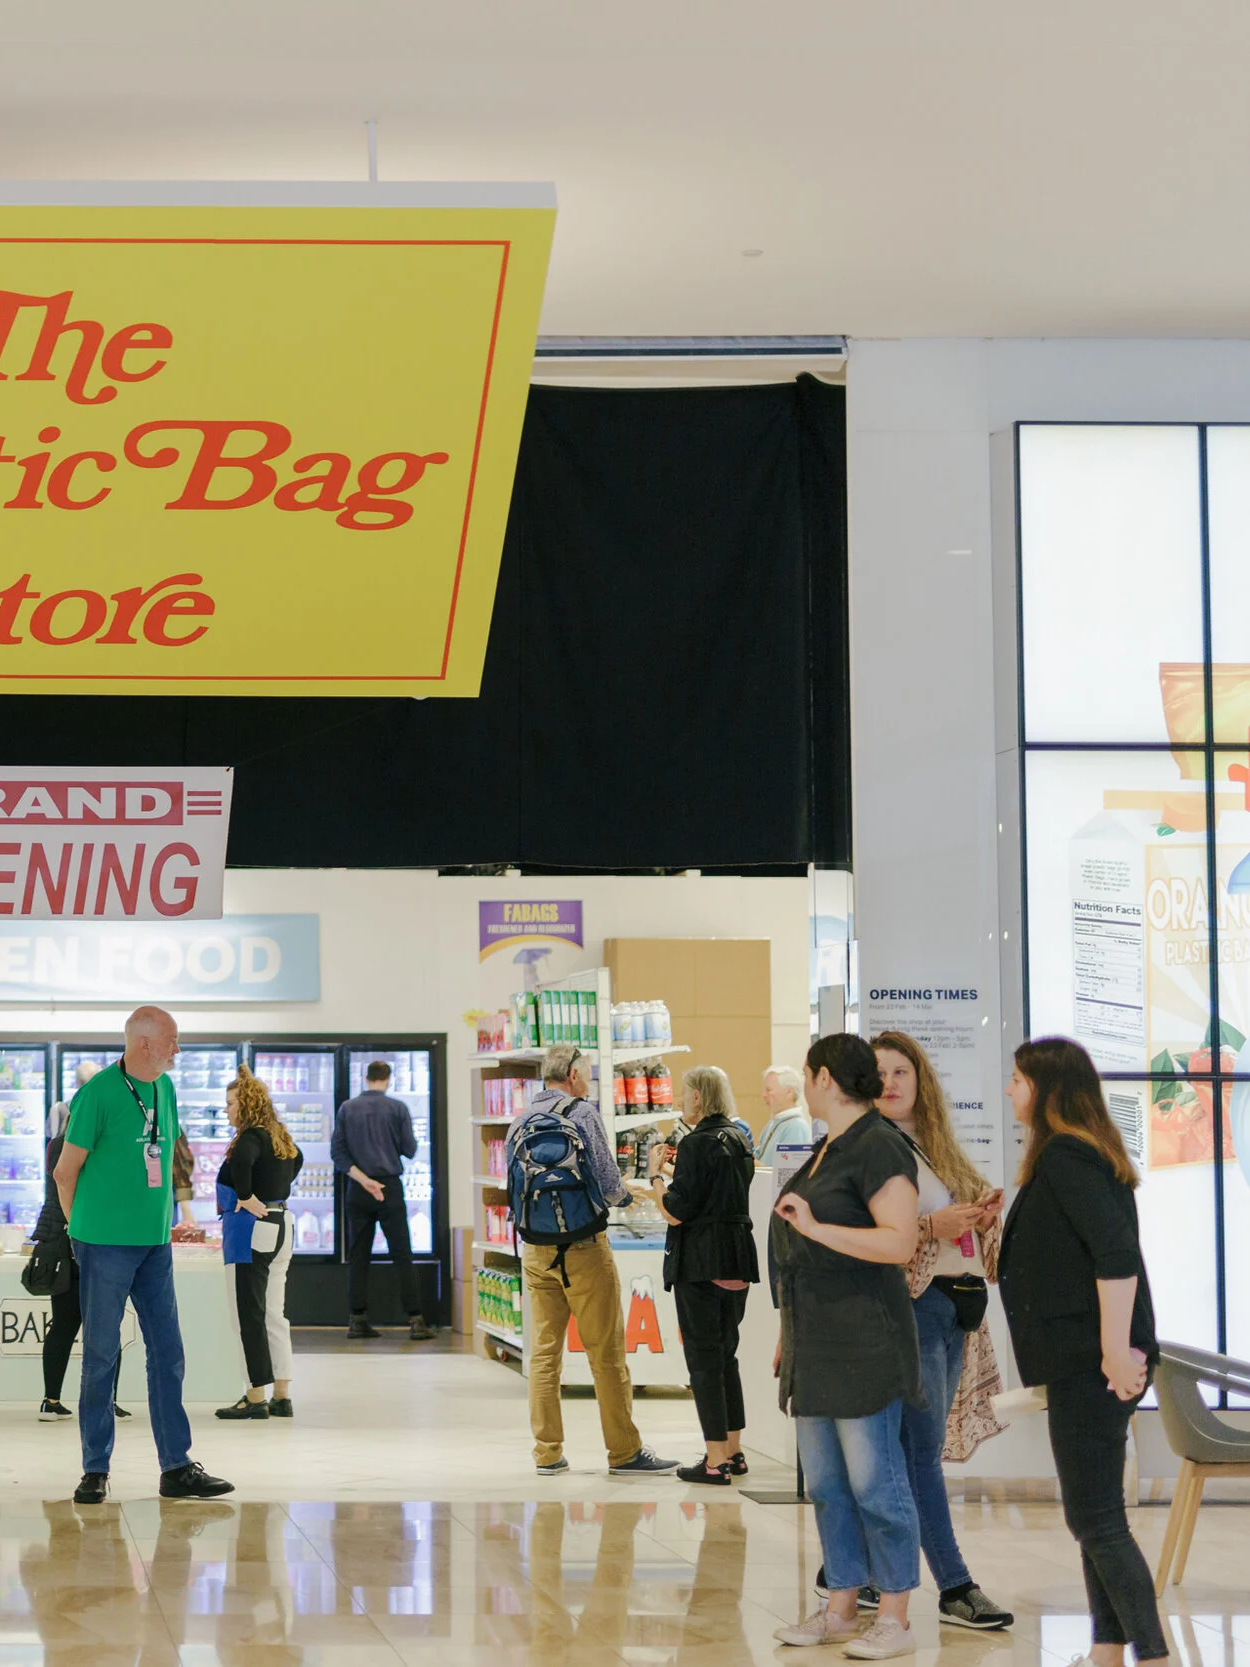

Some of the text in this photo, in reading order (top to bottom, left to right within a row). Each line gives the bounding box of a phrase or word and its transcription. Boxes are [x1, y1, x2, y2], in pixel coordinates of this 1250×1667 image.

[124, 421, 448, 530] Bag
[503, 903, 559, 923] FABAGS
[1074, 901, 1142, 915] Nutrition Facts
[524, 924, 538, 933] AND
[100, 936, 282, 984] FOOD
[870, 989, 978, 1000] OPENING TIMES
[909, 1018, 924, 1026] shop
[932, 1019, 946, 1027] your
[929, 1025, 955, 1034] opening
[2, 1311, 84, 1344] BAK
